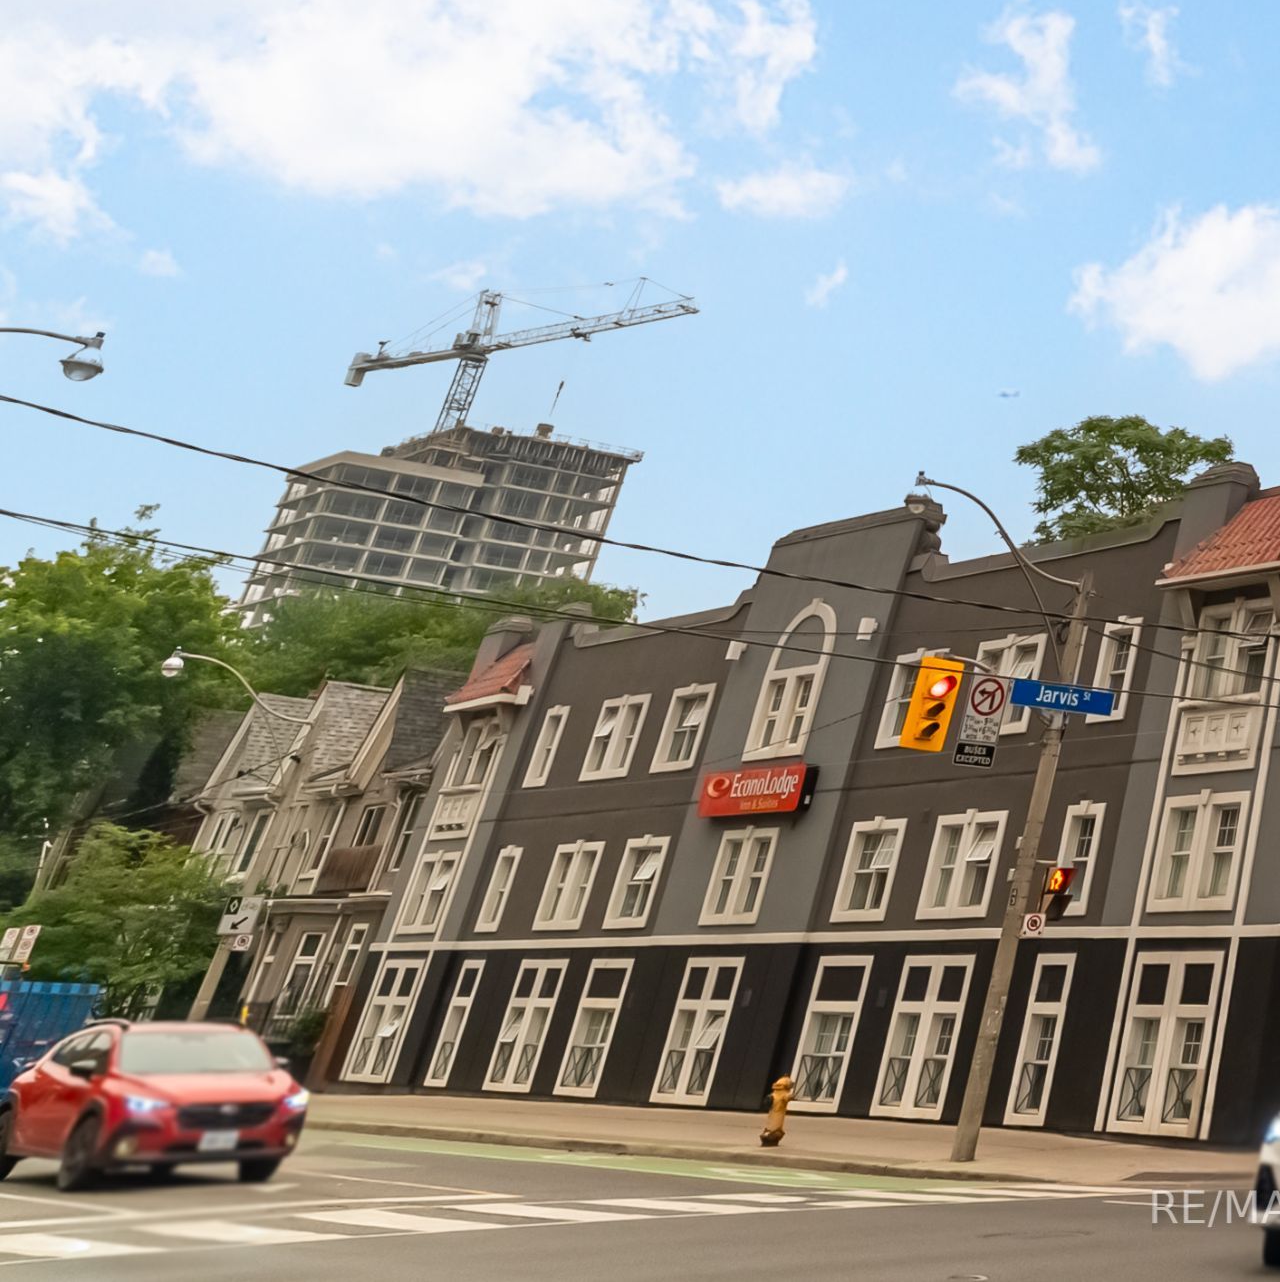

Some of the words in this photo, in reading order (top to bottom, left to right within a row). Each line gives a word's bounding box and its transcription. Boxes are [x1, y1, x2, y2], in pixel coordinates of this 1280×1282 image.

[1036, 685, 1079, 706] Jarvis
[1083, 691, 1091, 701] St
[730, 769, 799, 799] EconoLodge
